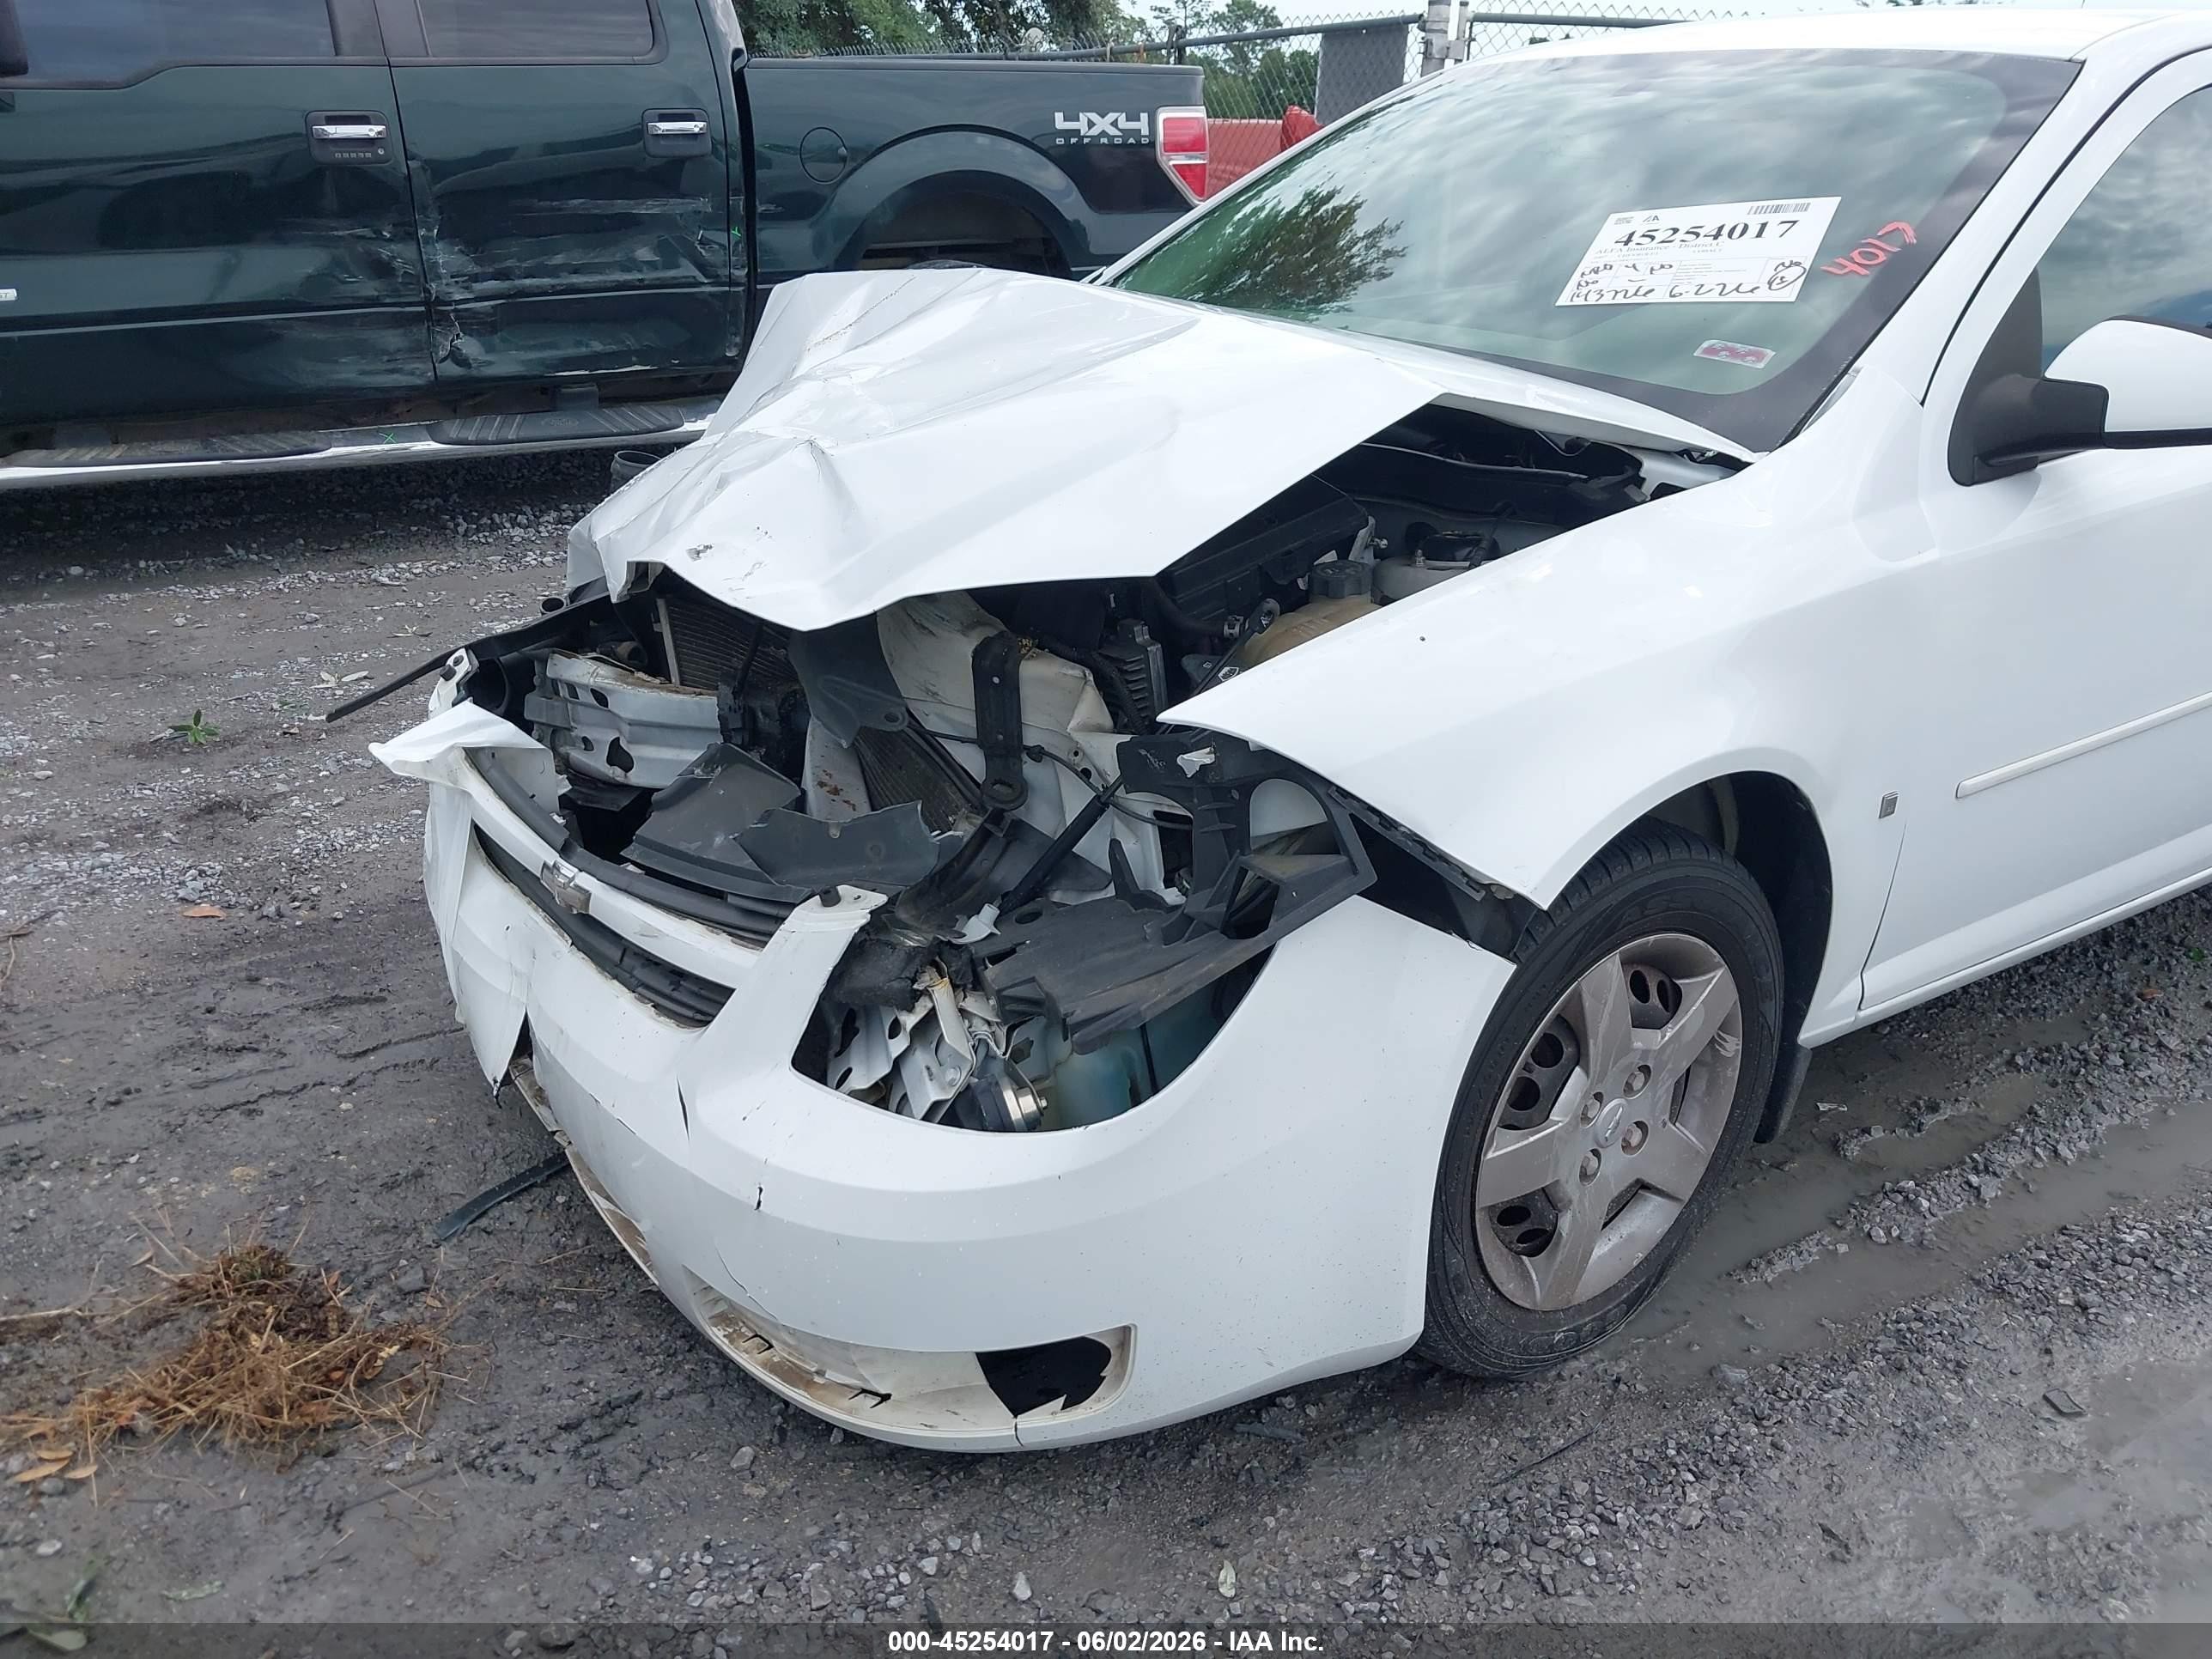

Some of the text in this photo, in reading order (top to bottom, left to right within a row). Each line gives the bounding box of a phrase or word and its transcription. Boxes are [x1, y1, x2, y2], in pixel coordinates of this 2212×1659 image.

[1054, 112, 1149, 136] 4X4
[1614, 220, 1800, 246] 45254017
[1820, 221, 1917, 276] 4017
